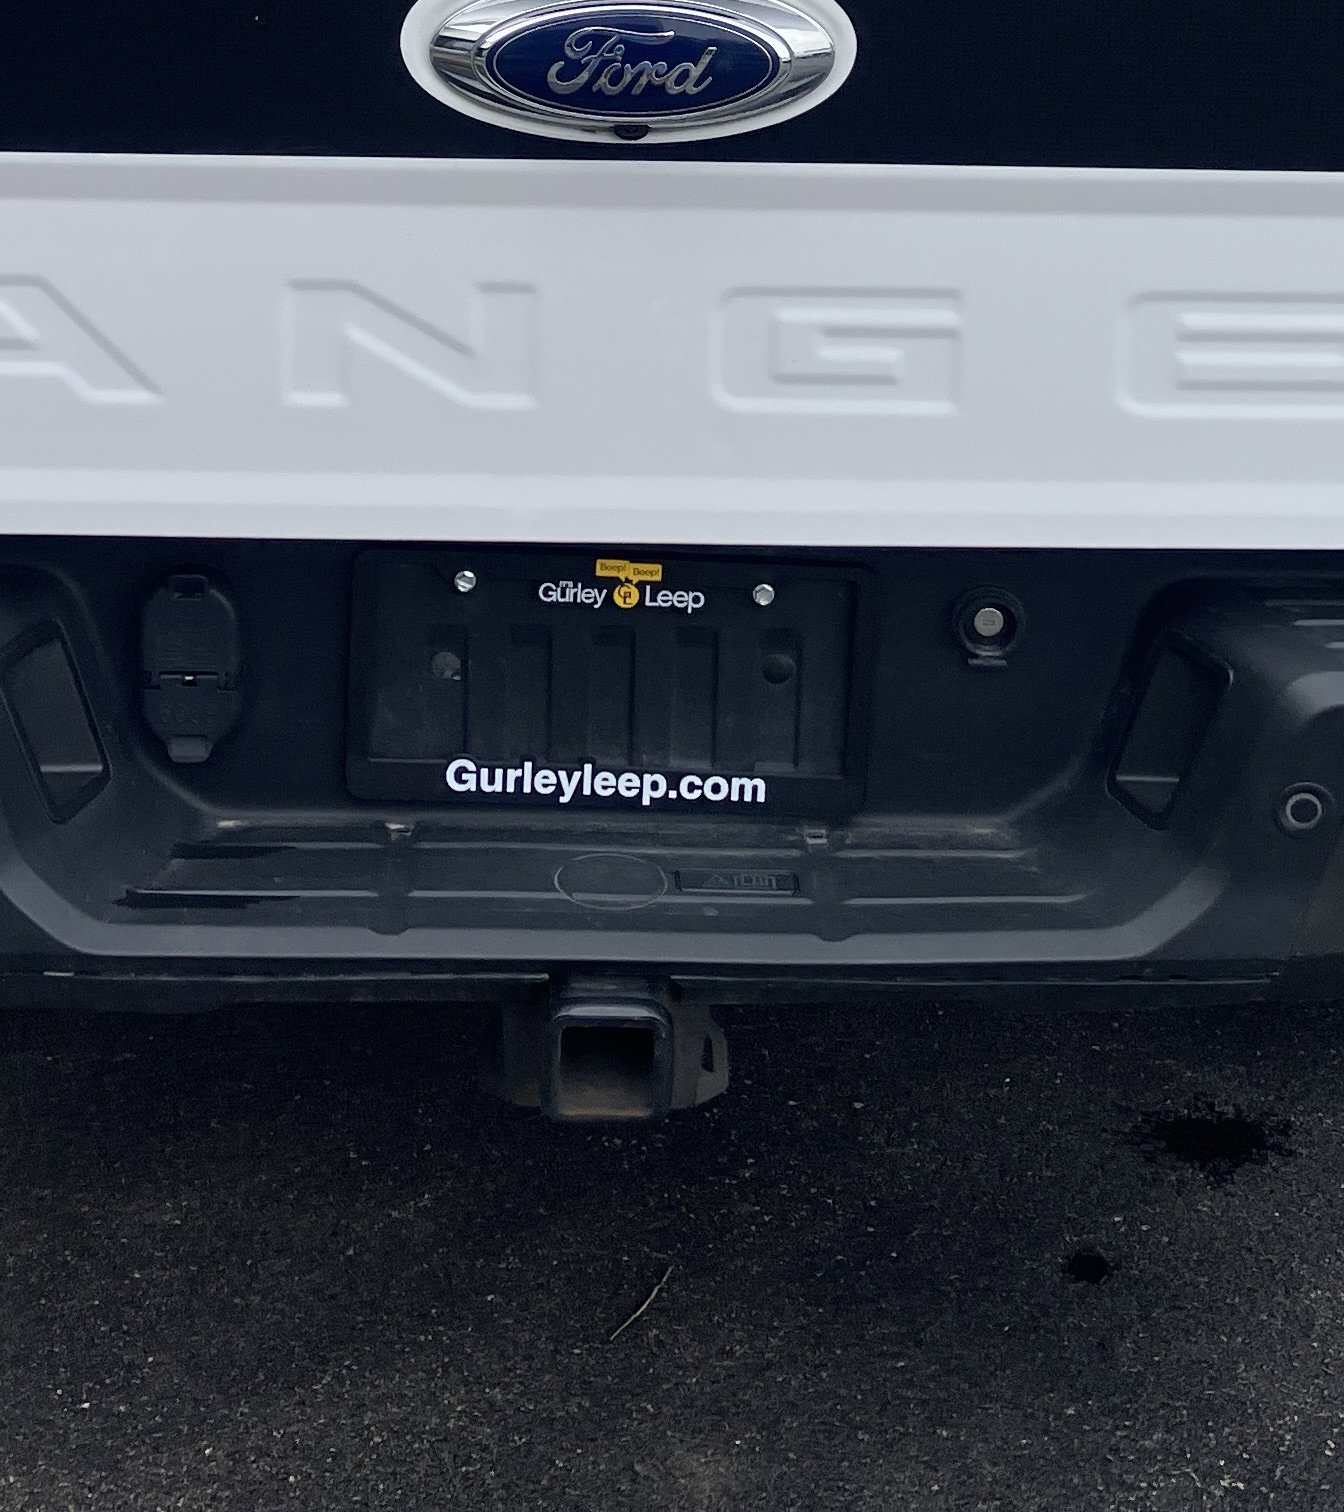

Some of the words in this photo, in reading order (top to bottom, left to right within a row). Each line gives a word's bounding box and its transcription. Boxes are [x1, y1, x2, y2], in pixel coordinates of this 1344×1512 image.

[547, 26, 718, 96] Ford
[599, 562, 627, 573] Beep!
[632, 567, 660, 577] Beep!
[538, 582, 608, 609] Gurley
[644, 585, 705, 614] Leep
[445, 758, 767, 806] Gurleyleep.com
